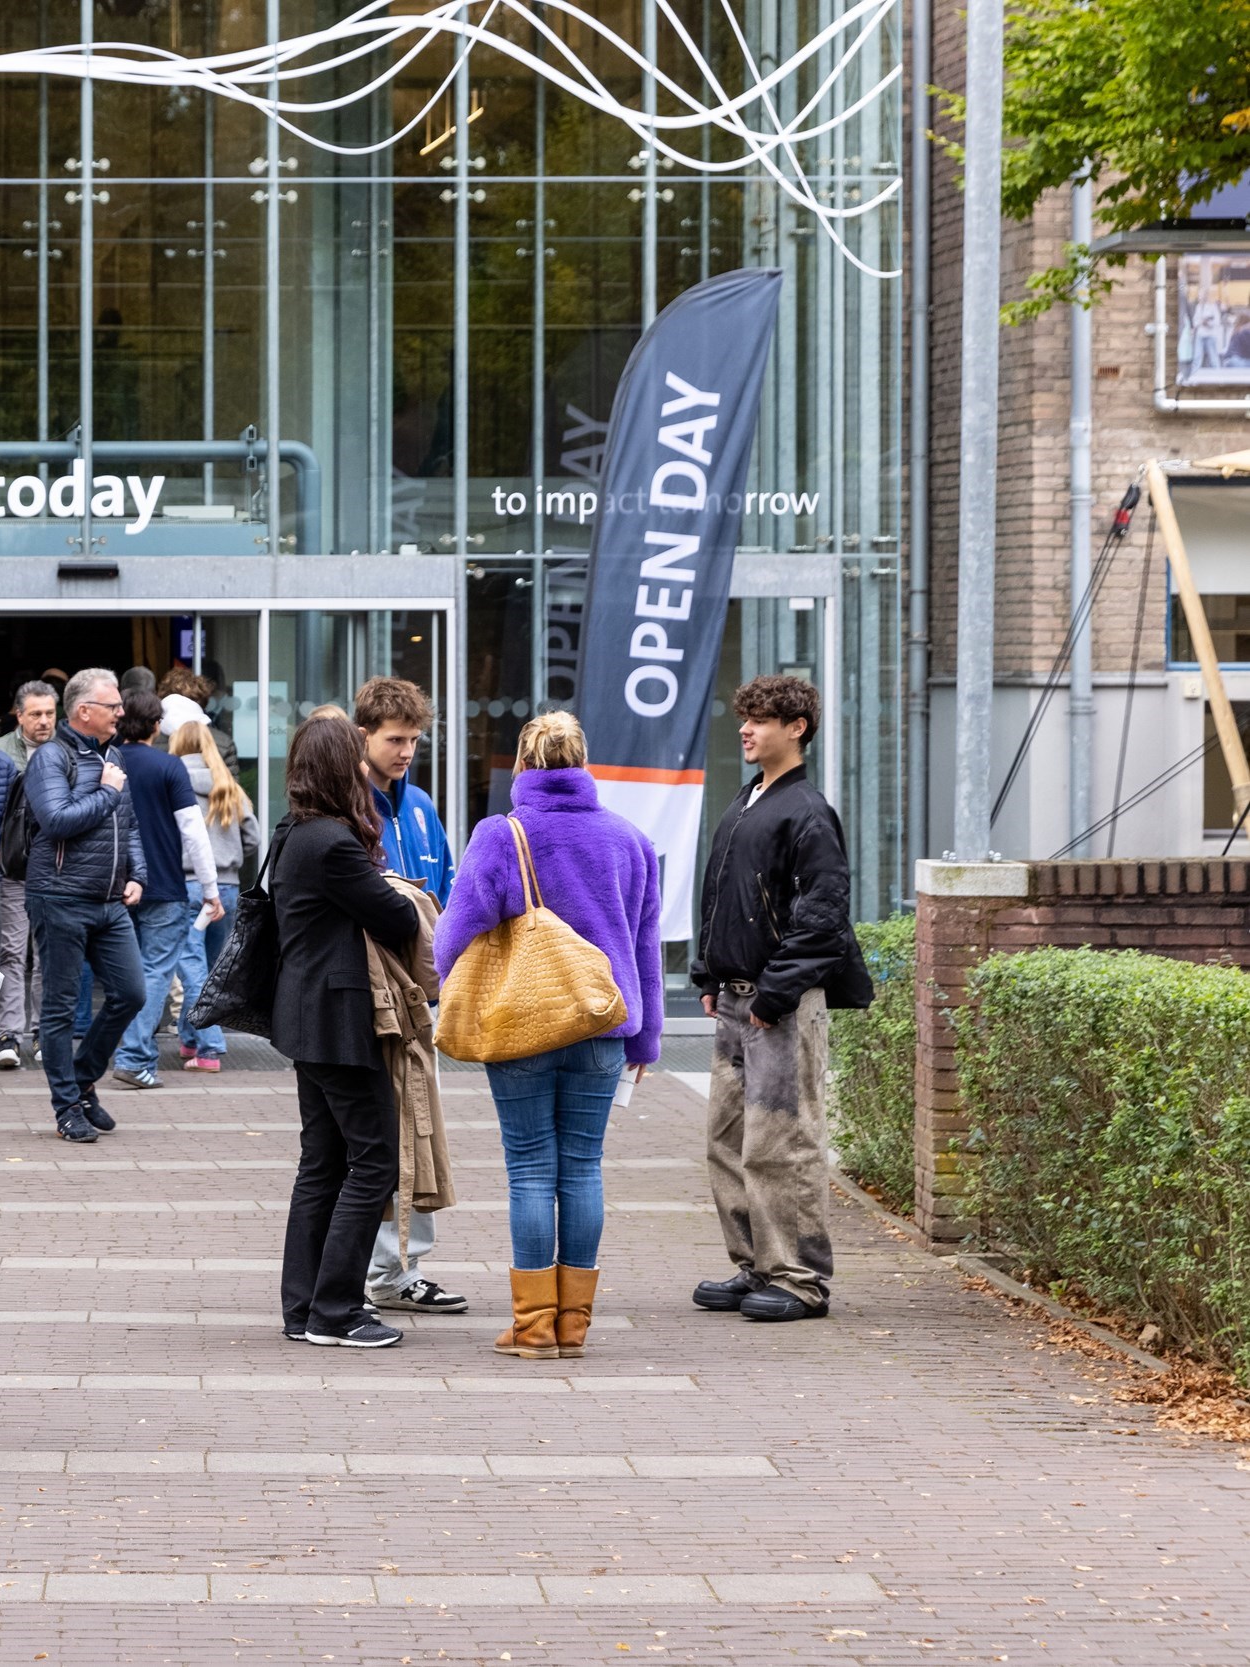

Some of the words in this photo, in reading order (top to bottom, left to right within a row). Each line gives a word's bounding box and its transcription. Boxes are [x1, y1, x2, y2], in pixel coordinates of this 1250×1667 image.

[491, 486, 527, 515] to
[658, 488, 820, 516] morrow
[650, 371, 721, 511] DAY
[624, 530, 701, 718] OPEN
